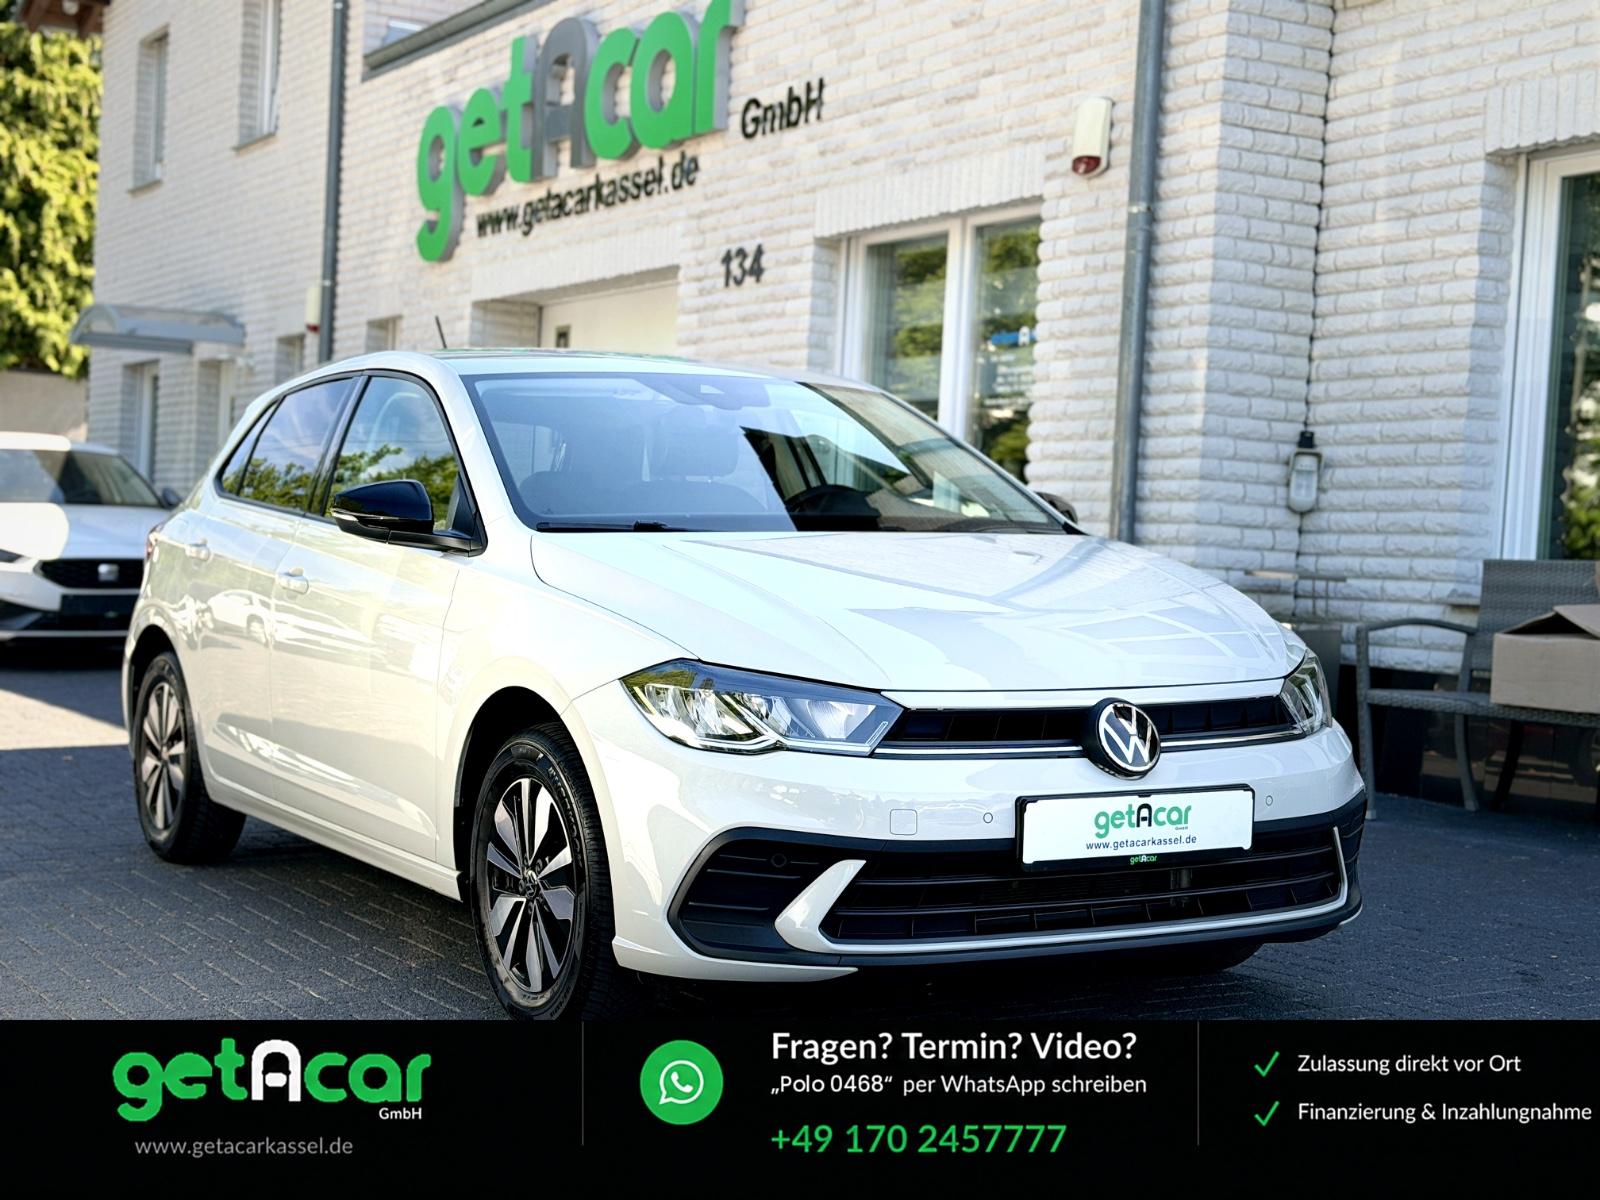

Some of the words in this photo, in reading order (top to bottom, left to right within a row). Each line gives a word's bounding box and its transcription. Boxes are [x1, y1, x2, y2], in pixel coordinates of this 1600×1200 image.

[417, 0, 745, 262] getAcar
[741, 78, 826, 139] GmbH
[476, 150, 700, 238] www.getacarkassel.de
[720, 243, 765, 288] 134
[1094, 803, 1192, 839] getAcar
[1085, 834, 1197, 851] www.getacarkassel.de
[1129, 854, 1158, 865] getAcar
